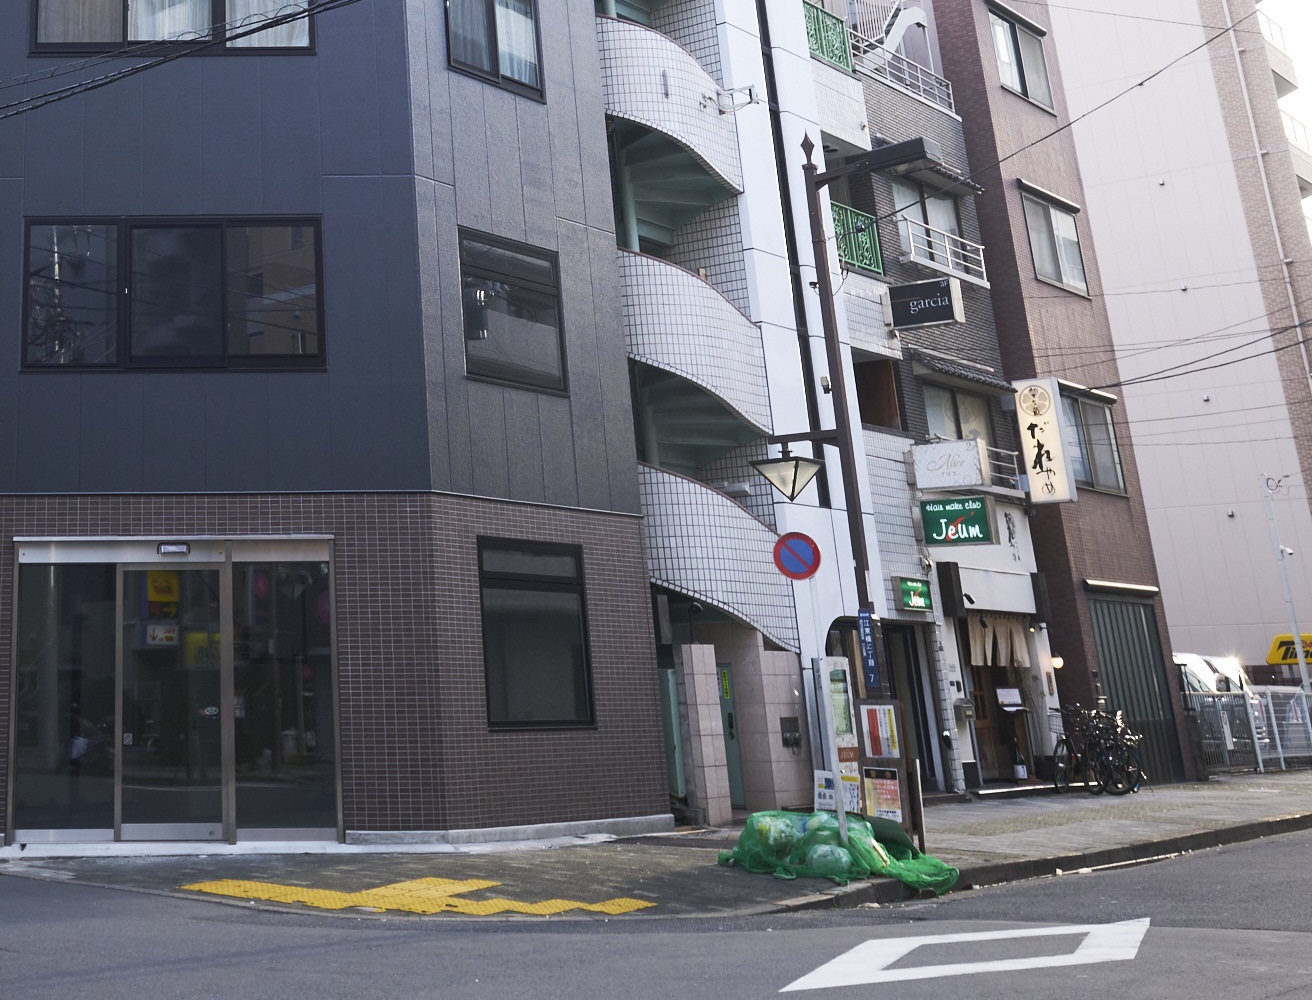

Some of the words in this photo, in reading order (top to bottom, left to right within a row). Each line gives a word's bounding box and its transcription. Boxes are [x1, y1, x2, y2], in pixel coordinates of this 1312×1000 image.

[909, 293, 950, 314] garcia
[927, 453, 965, 472] Alice
[1026, 421, 1055, 496] だれやめ
[945, 501, 964, 511] make
